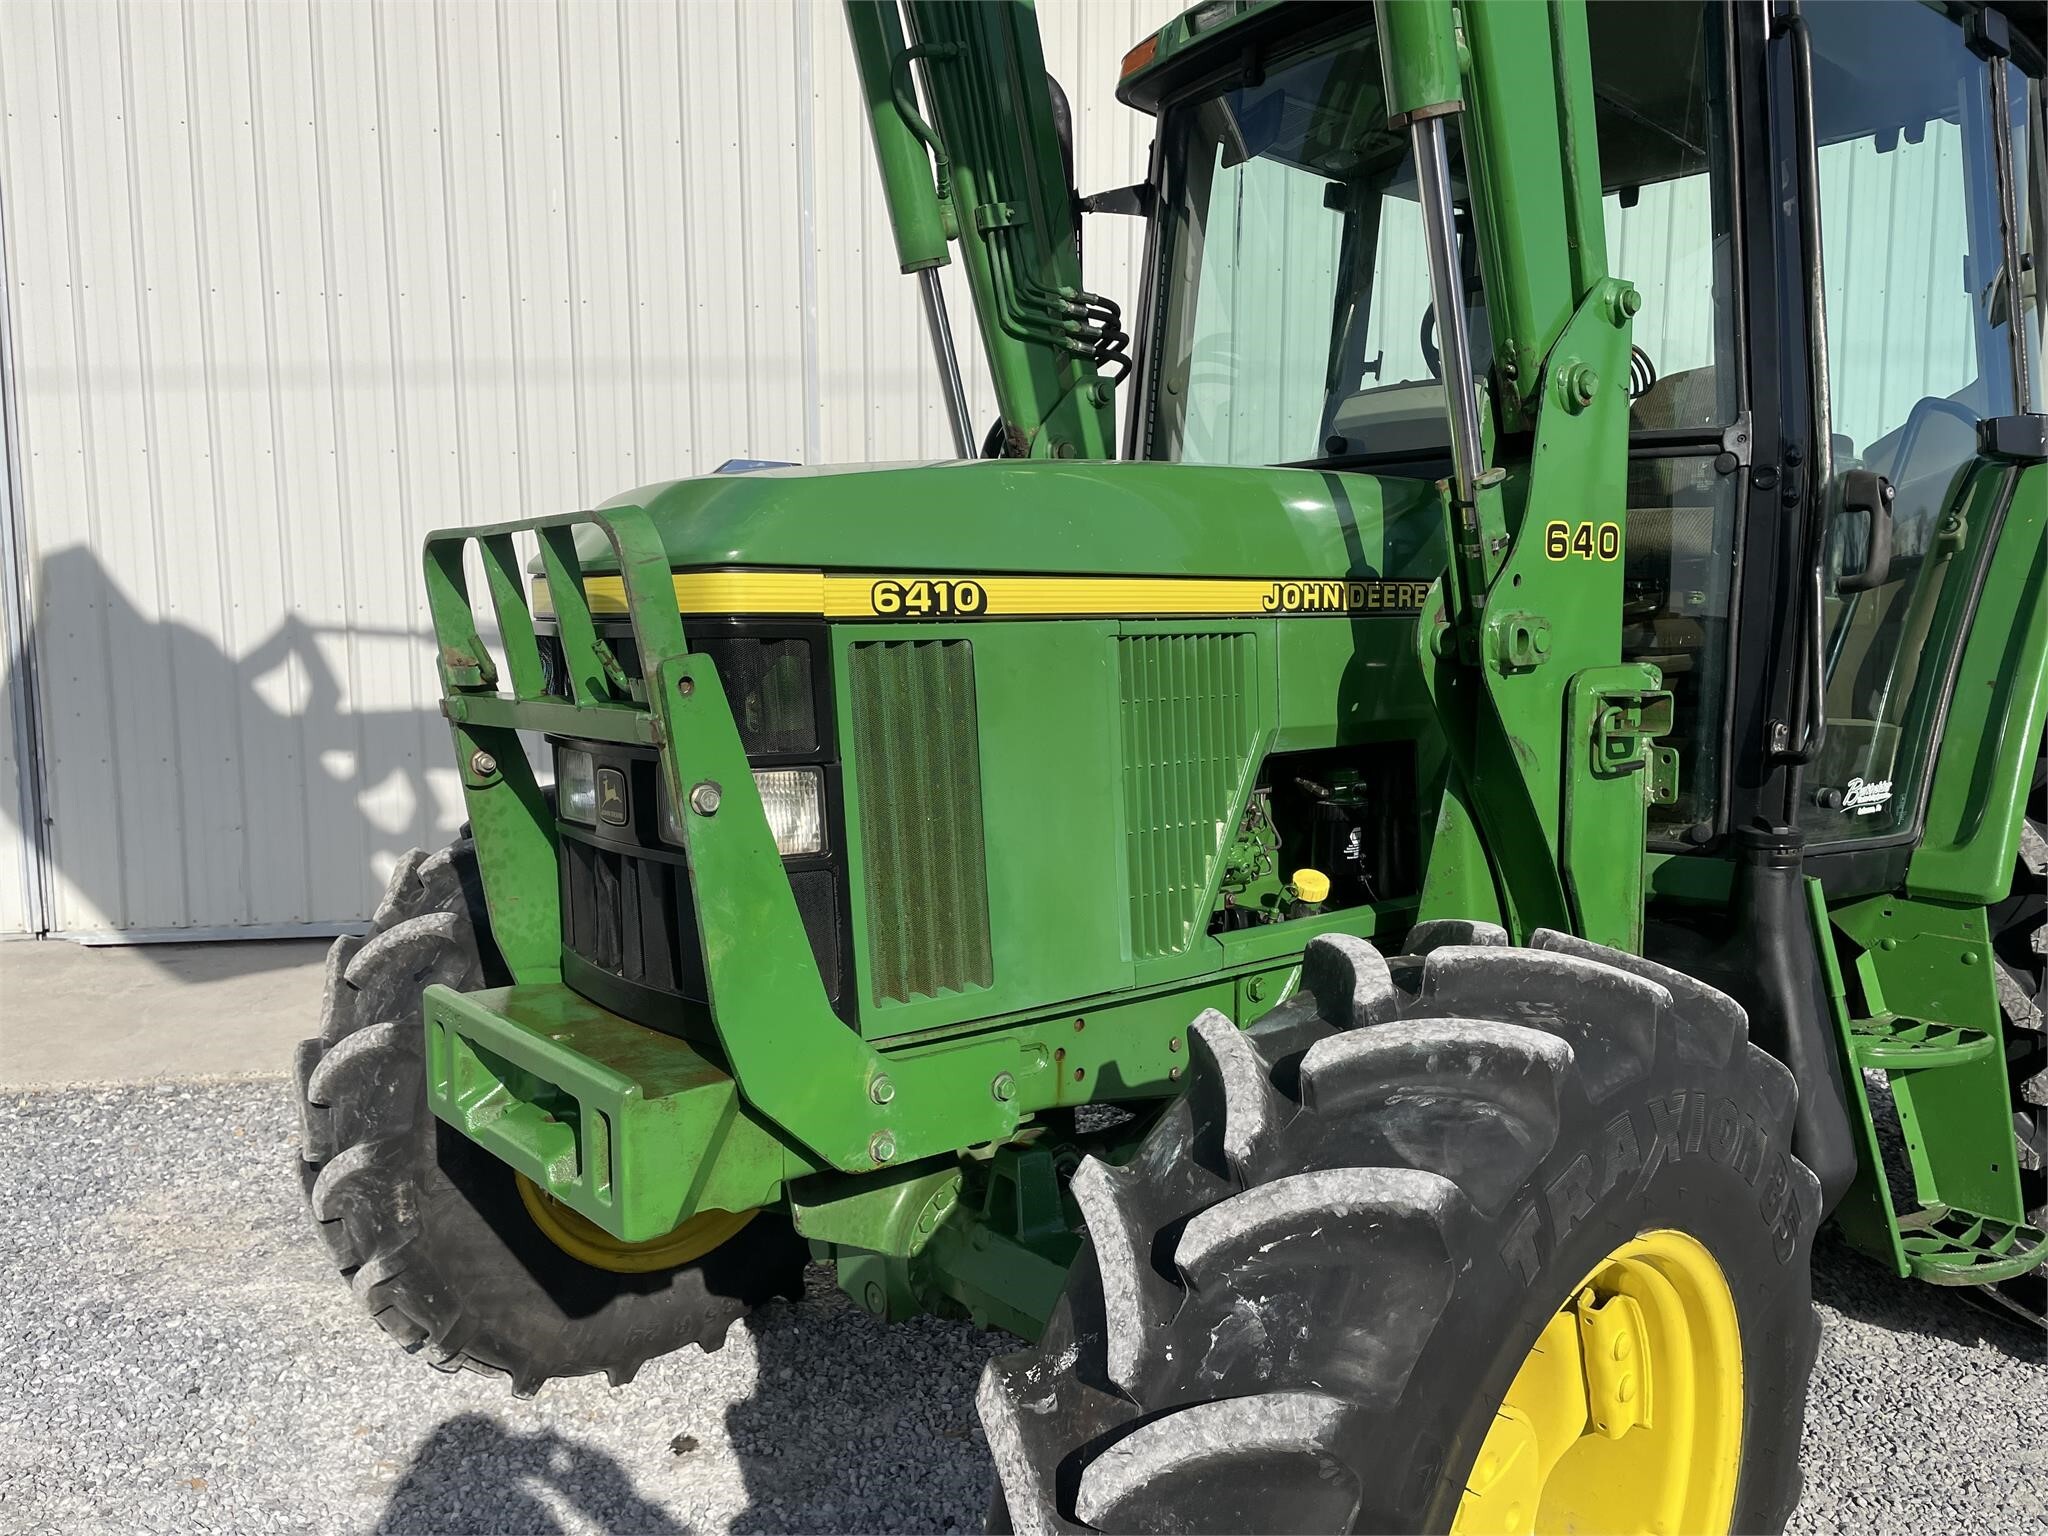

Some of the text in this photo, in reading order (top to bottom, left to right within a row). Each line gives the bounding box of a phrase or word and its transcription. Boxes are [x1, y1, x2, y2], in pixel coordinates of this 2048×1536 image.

[1545, 520, 1620, 561] 640
[871, 580, 987, 617] 6410
[1263, 583, 1429, 612] JOHN DEERE
[1500, 1088, 1802, 1289] TRAXION 85
